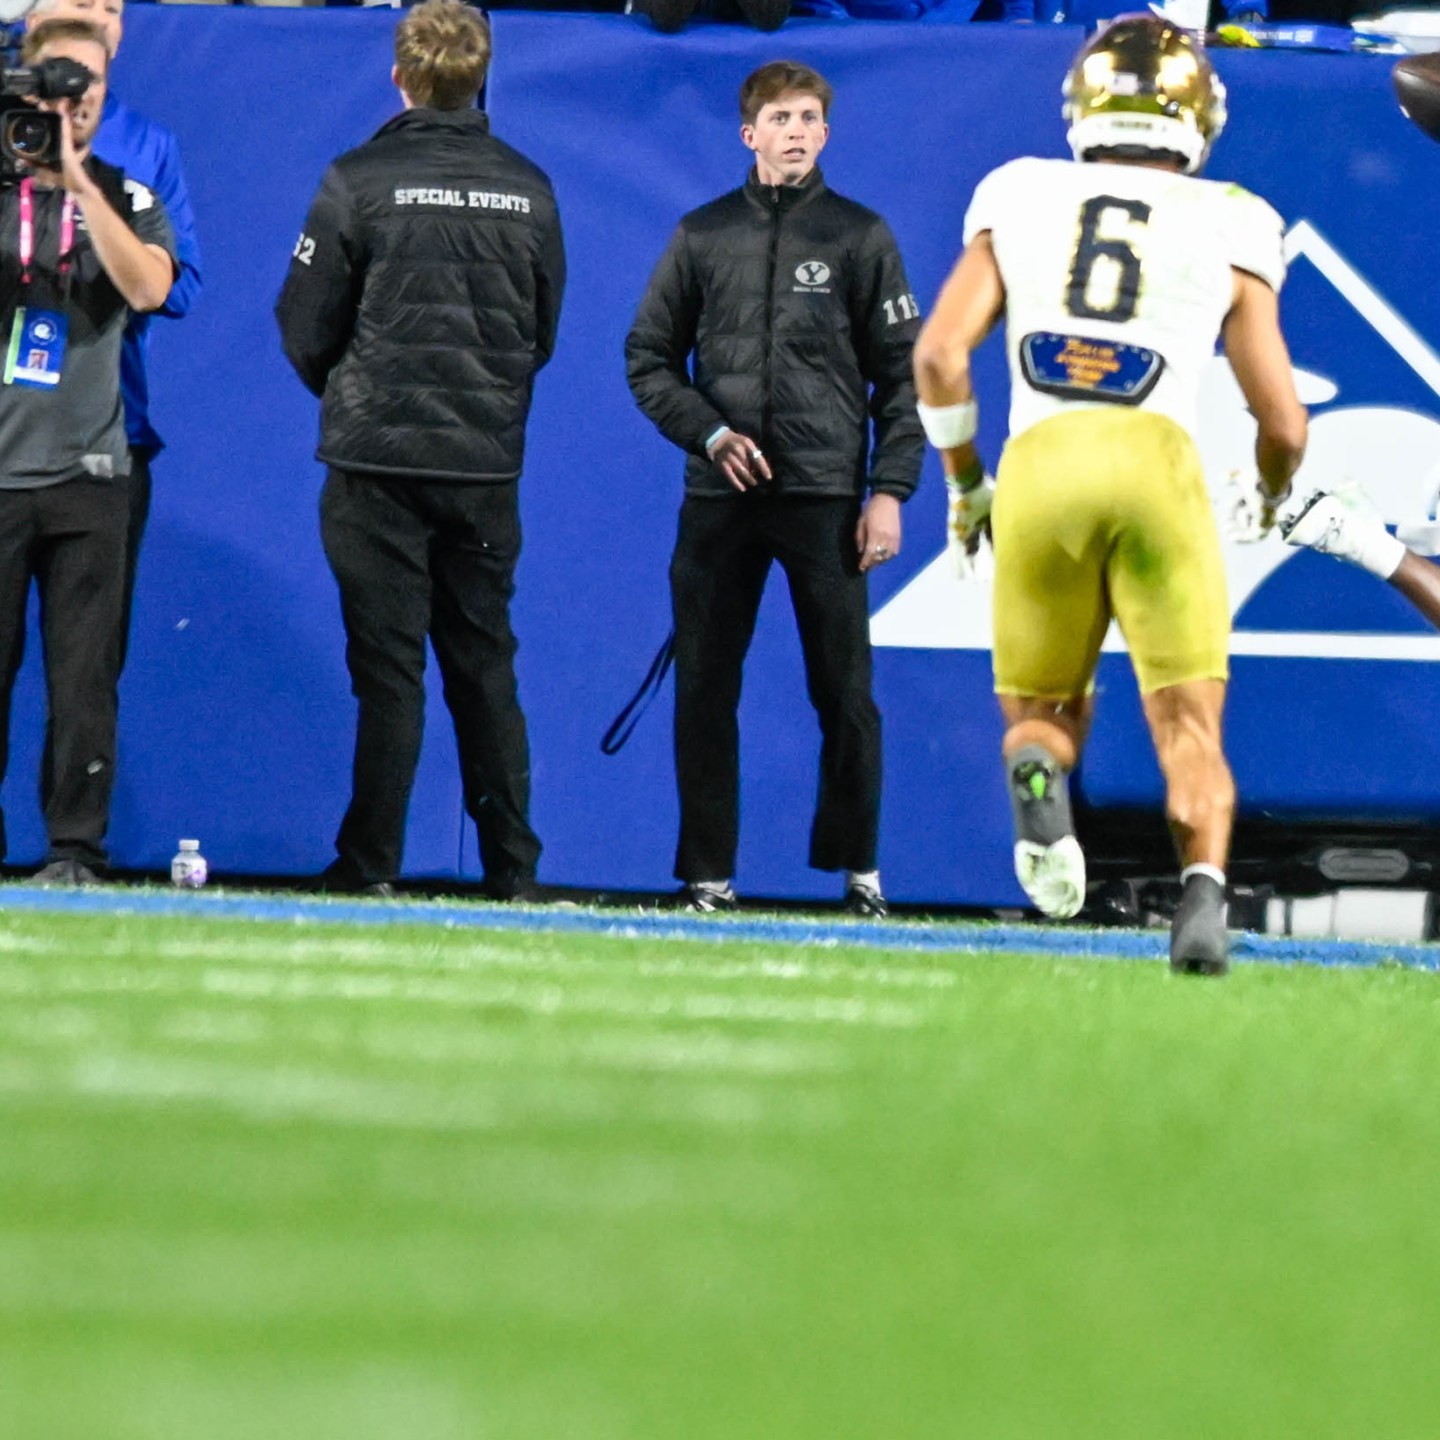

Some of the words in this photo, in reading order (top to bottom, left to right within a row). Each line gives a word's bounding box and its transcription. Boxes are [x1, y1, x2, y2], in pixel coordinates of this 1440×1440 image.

[395, 187, 465, 206] SPECIAL
[468, 191, 531, 213] EVENTS
[1064, 195, 1152, 324] 6
